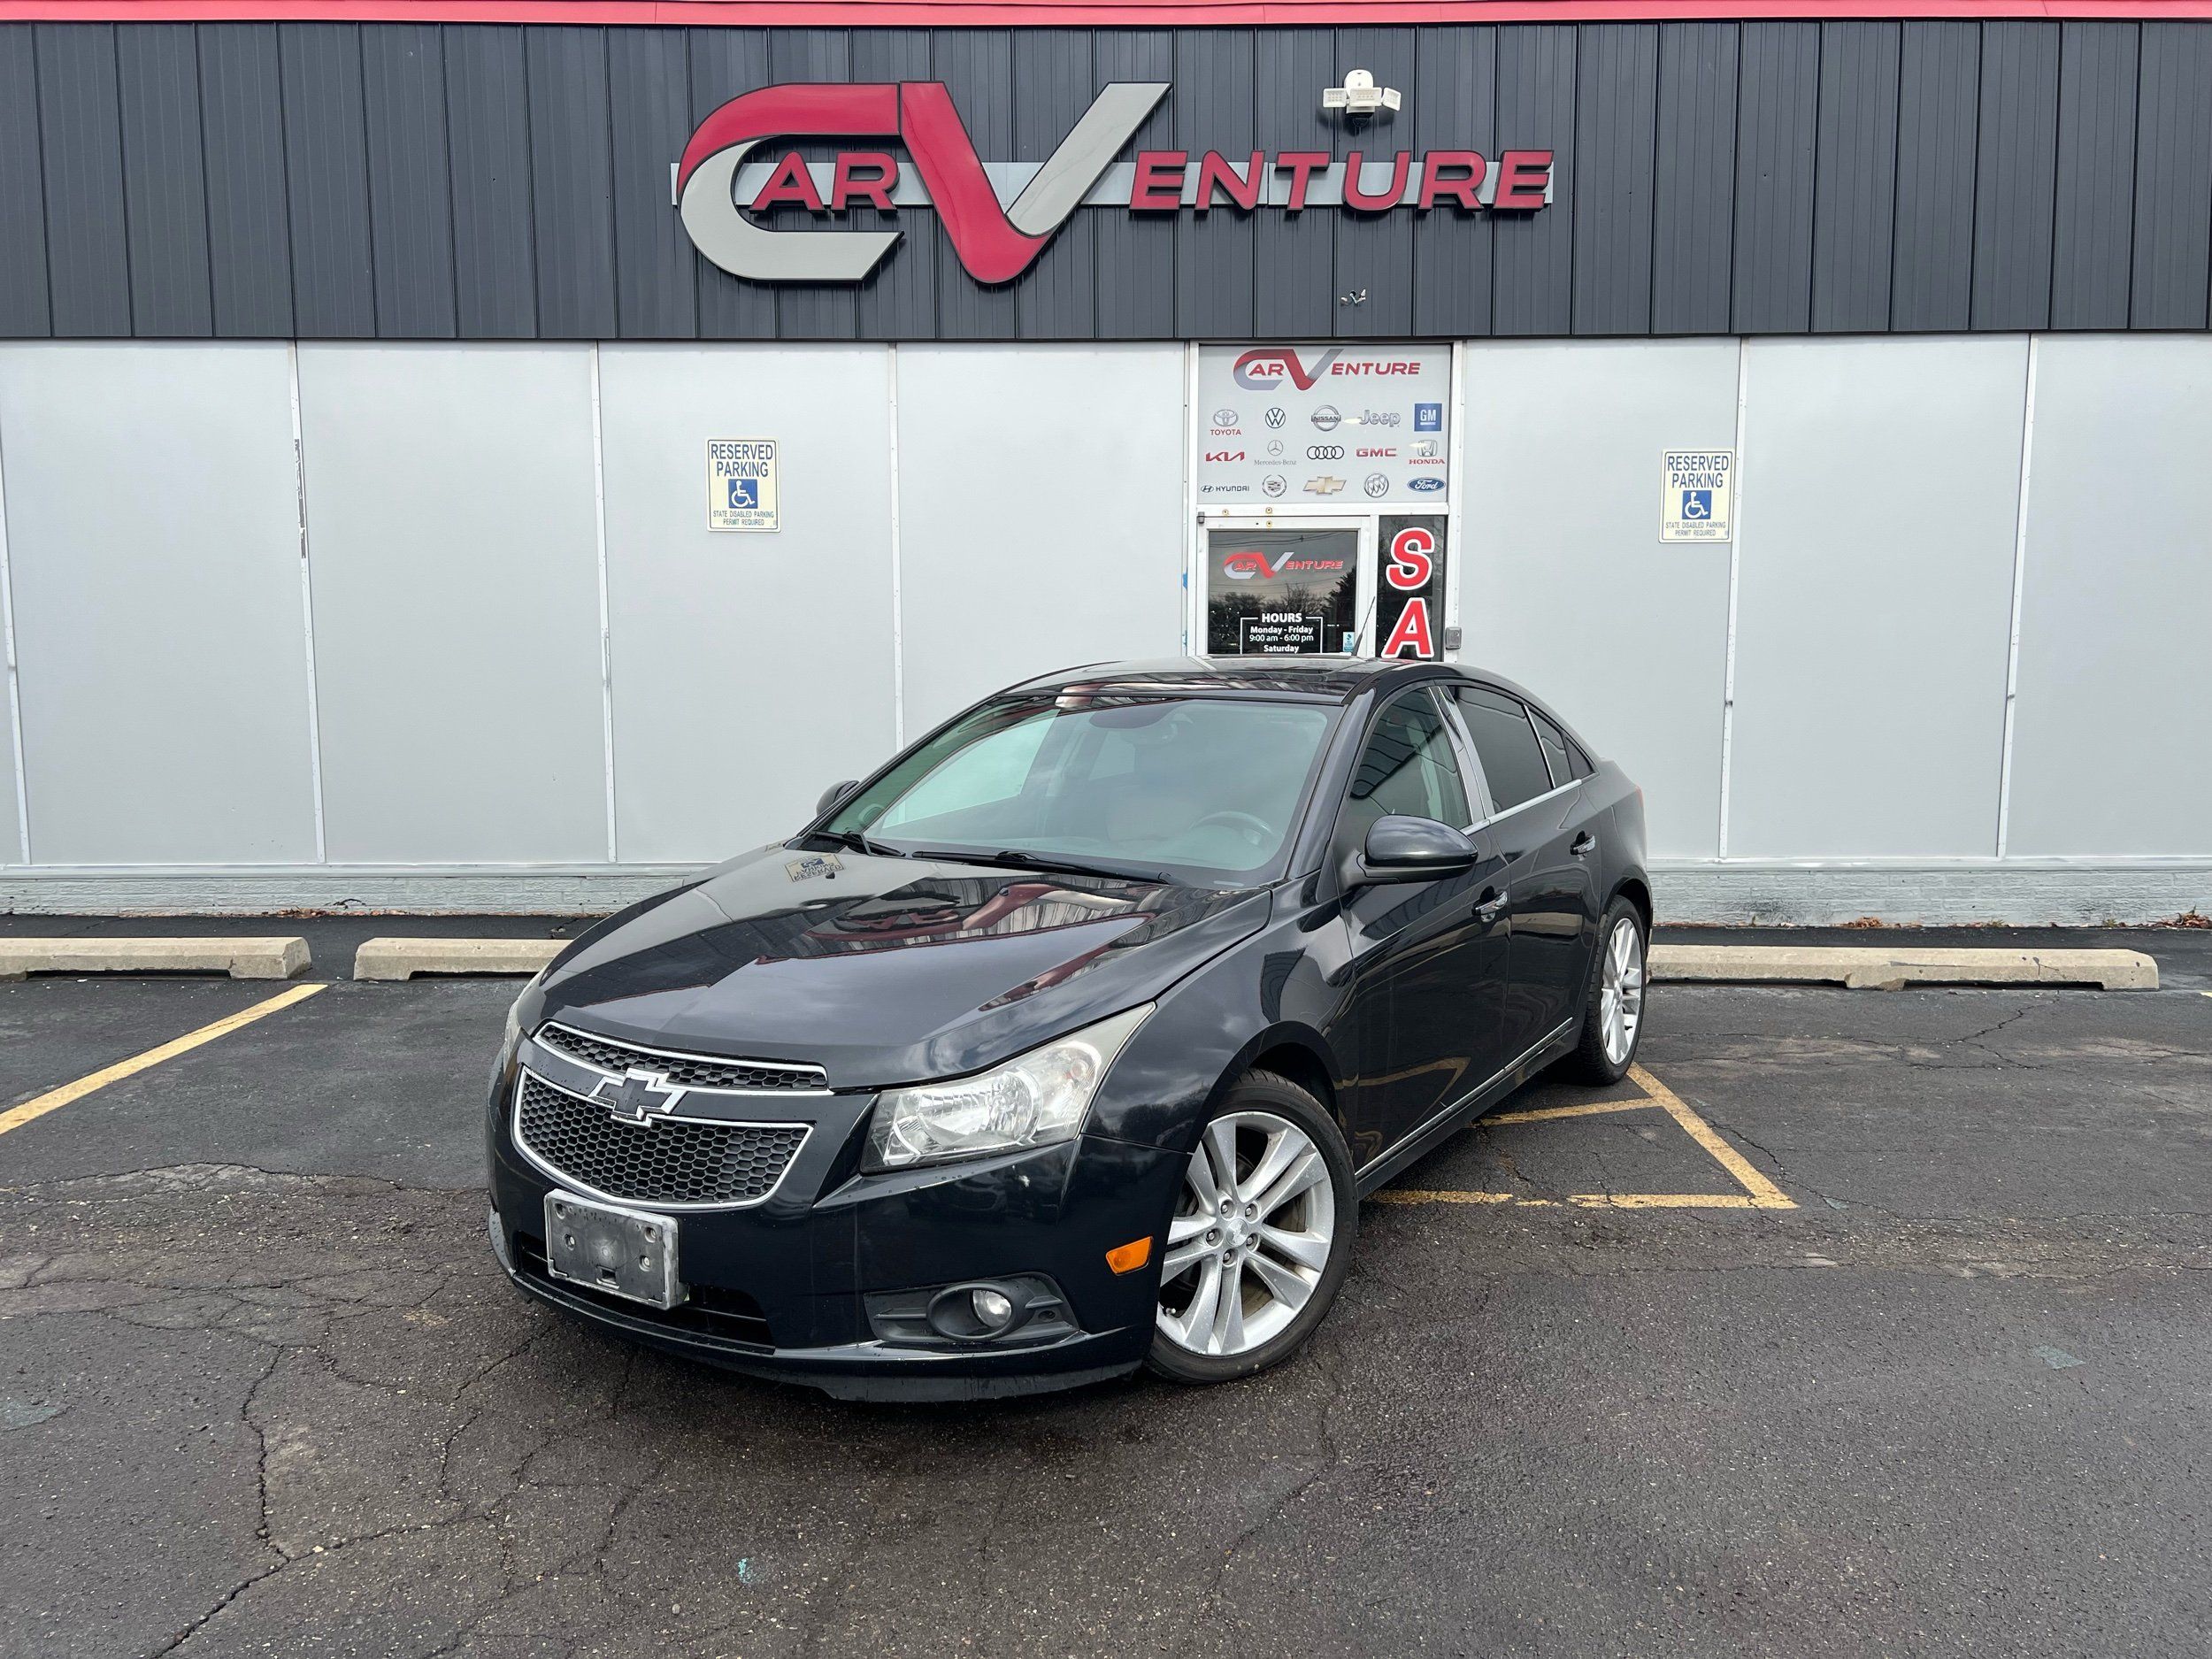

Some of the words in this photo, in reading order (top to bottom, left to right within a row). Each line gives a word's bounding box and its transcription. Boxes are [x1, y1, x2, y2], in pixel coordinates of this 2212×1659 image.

[1358, 410, 1401, 427] Jeep
[1420, 410, 1437, 421] GM
[711, 444, 773, 459] RESERVED
[1205, 451, 1245, 462] KIA
[1356, 448, 1396, 457] GMC
[1668, 456, 1729, 471] RESERVED
[717, 462, 768, 477] PARKING
[1415, 479, 1439, 490] Ford
[1672, 473, 1723, 488] PARKING
[1262, 612, 1302, 623] HOURS
[1288, 626, 1313, 634] Friday
[1263, 644, 1300, 653] Saturday
